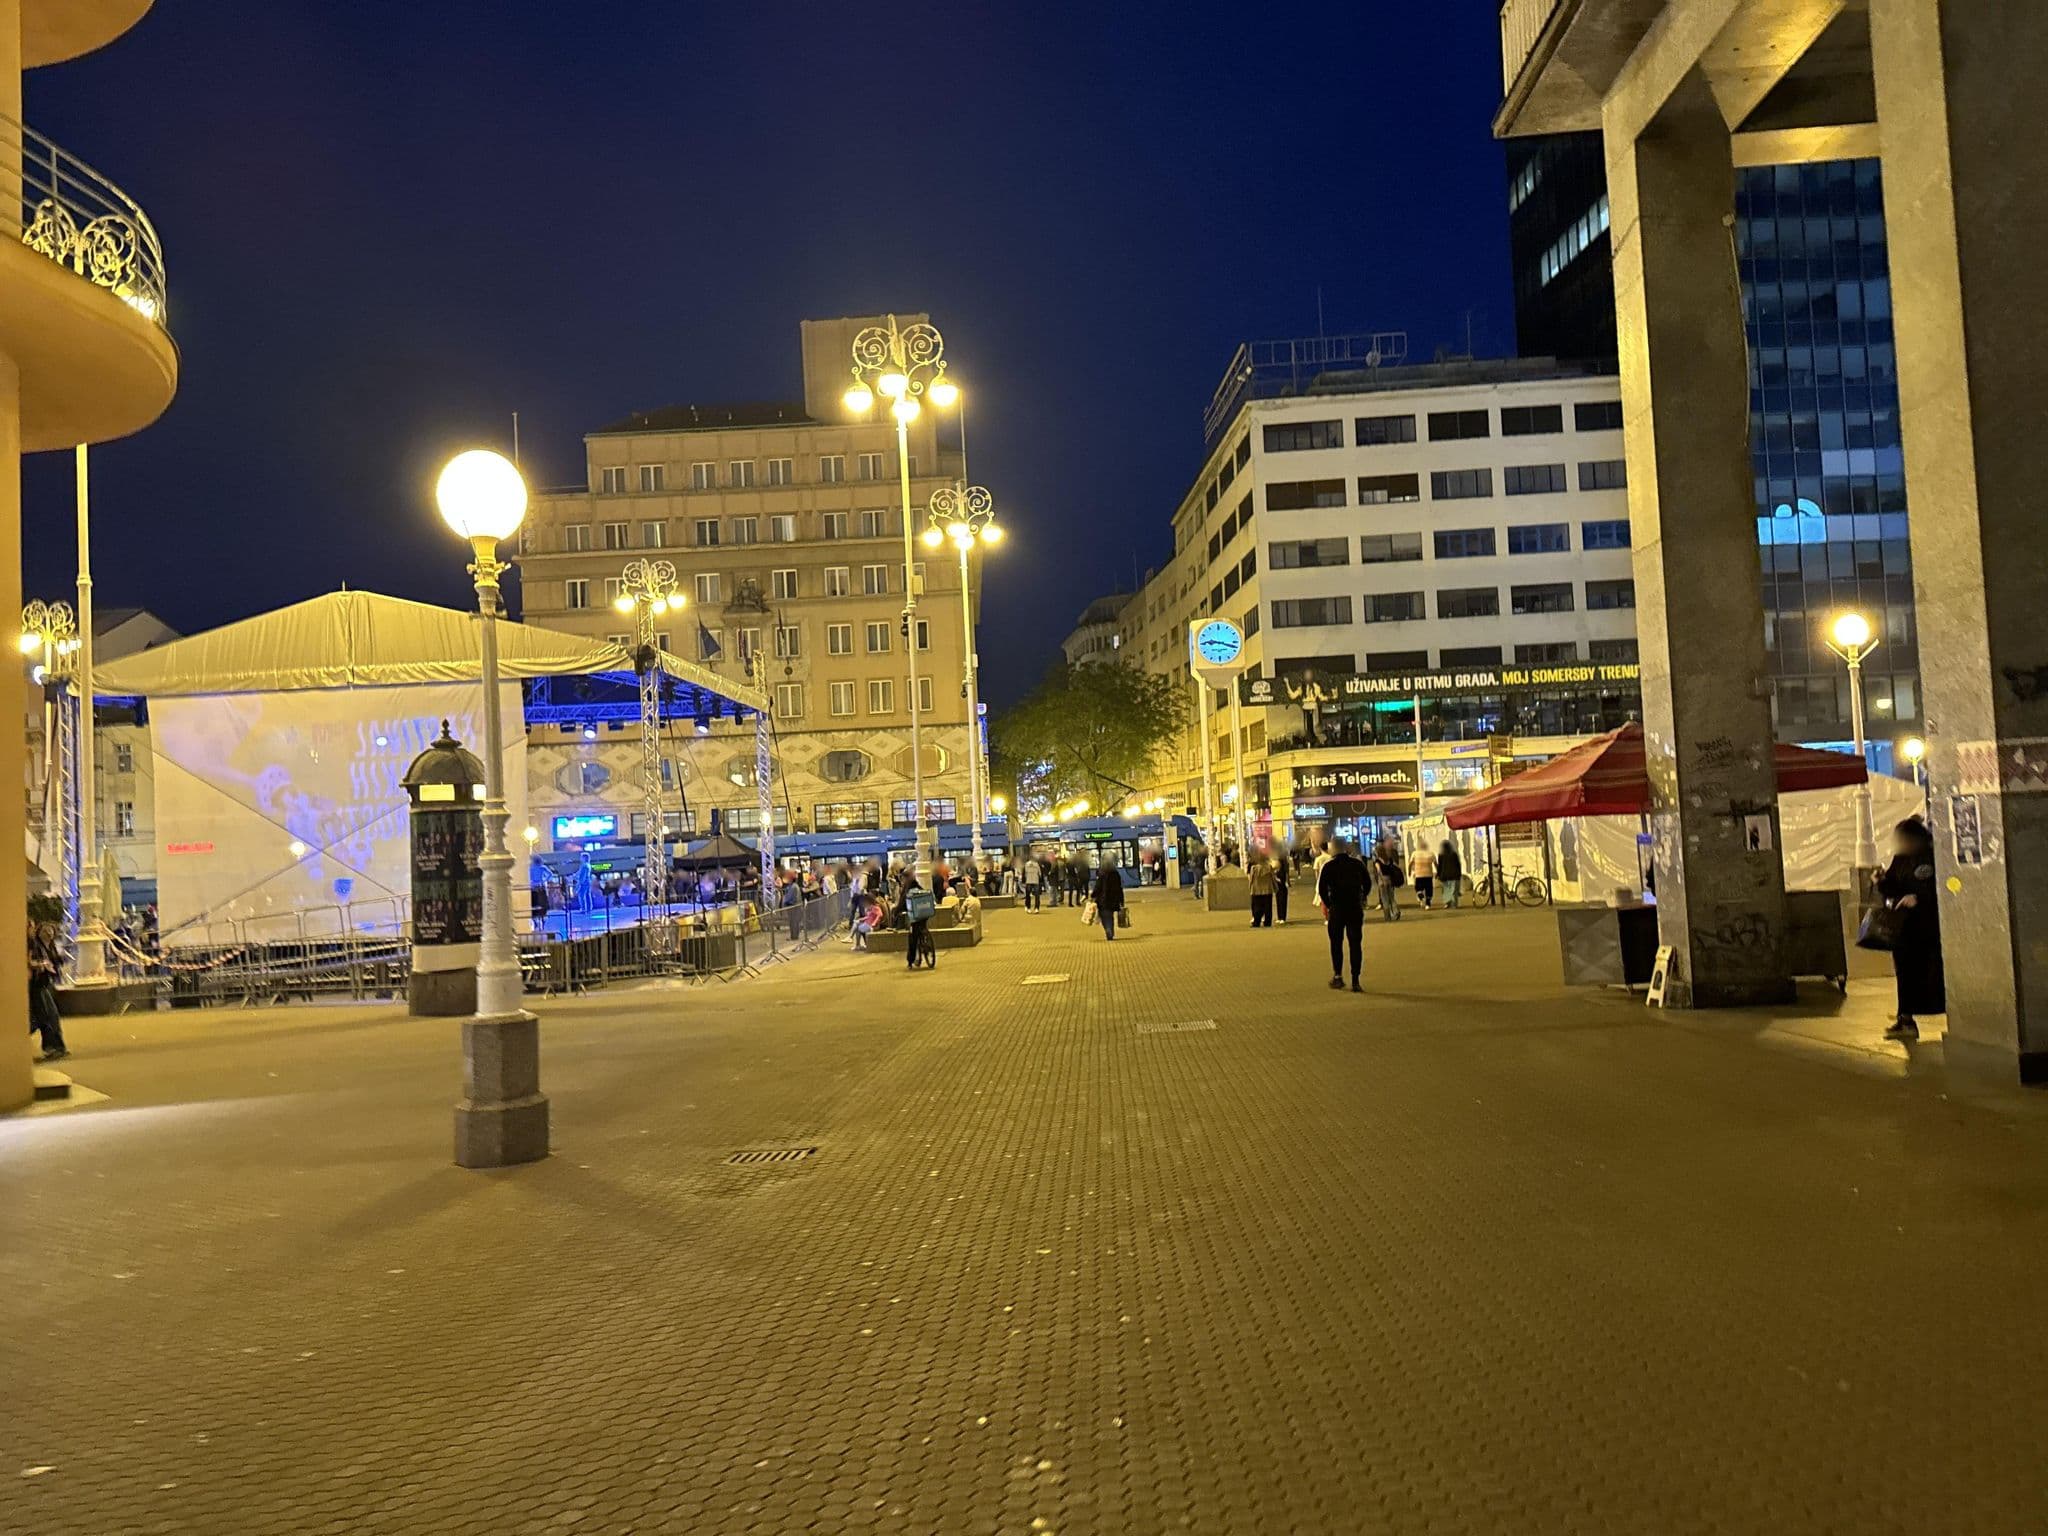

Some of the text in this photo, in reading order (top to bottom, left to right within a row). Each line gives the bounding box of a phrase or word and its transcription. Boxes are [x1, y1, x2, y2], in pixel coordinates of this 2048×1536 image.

[1345, 664, 1640, 694] UŽIVANJE U RITMU GRADA. MOJ SOMERSBY TRENU
[1303, 774, 1337, 788] biraš
[1339, 769, 1411, 785] Telemach.
